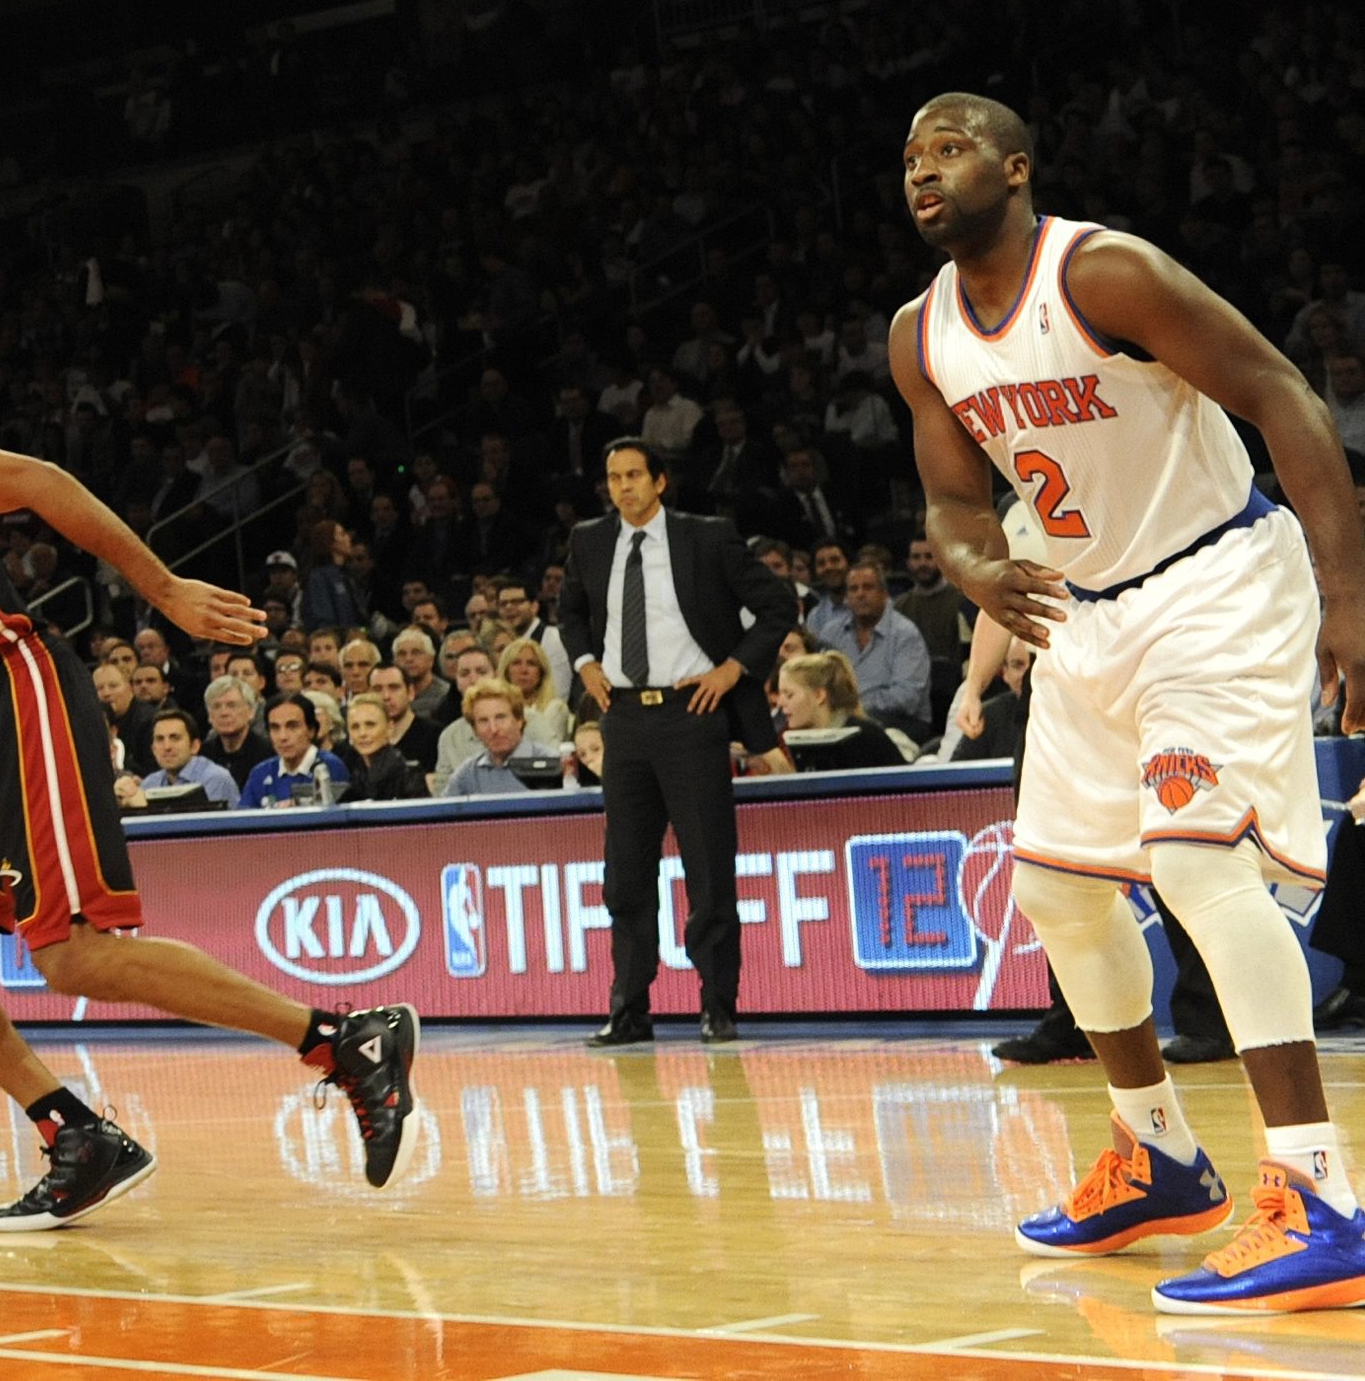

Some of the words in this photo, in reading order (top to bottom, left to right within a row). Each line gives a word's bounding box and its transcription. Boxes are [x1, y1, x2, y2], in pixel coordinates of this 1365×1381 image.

[951, 386, 1007, 444] EW
[997, 374, 1119, 430] YORK
[1014, 449, 1092, 539] 2
[1141, 753, 1219, 788] KNICKS
[281, 893, 393, 958] KIA
